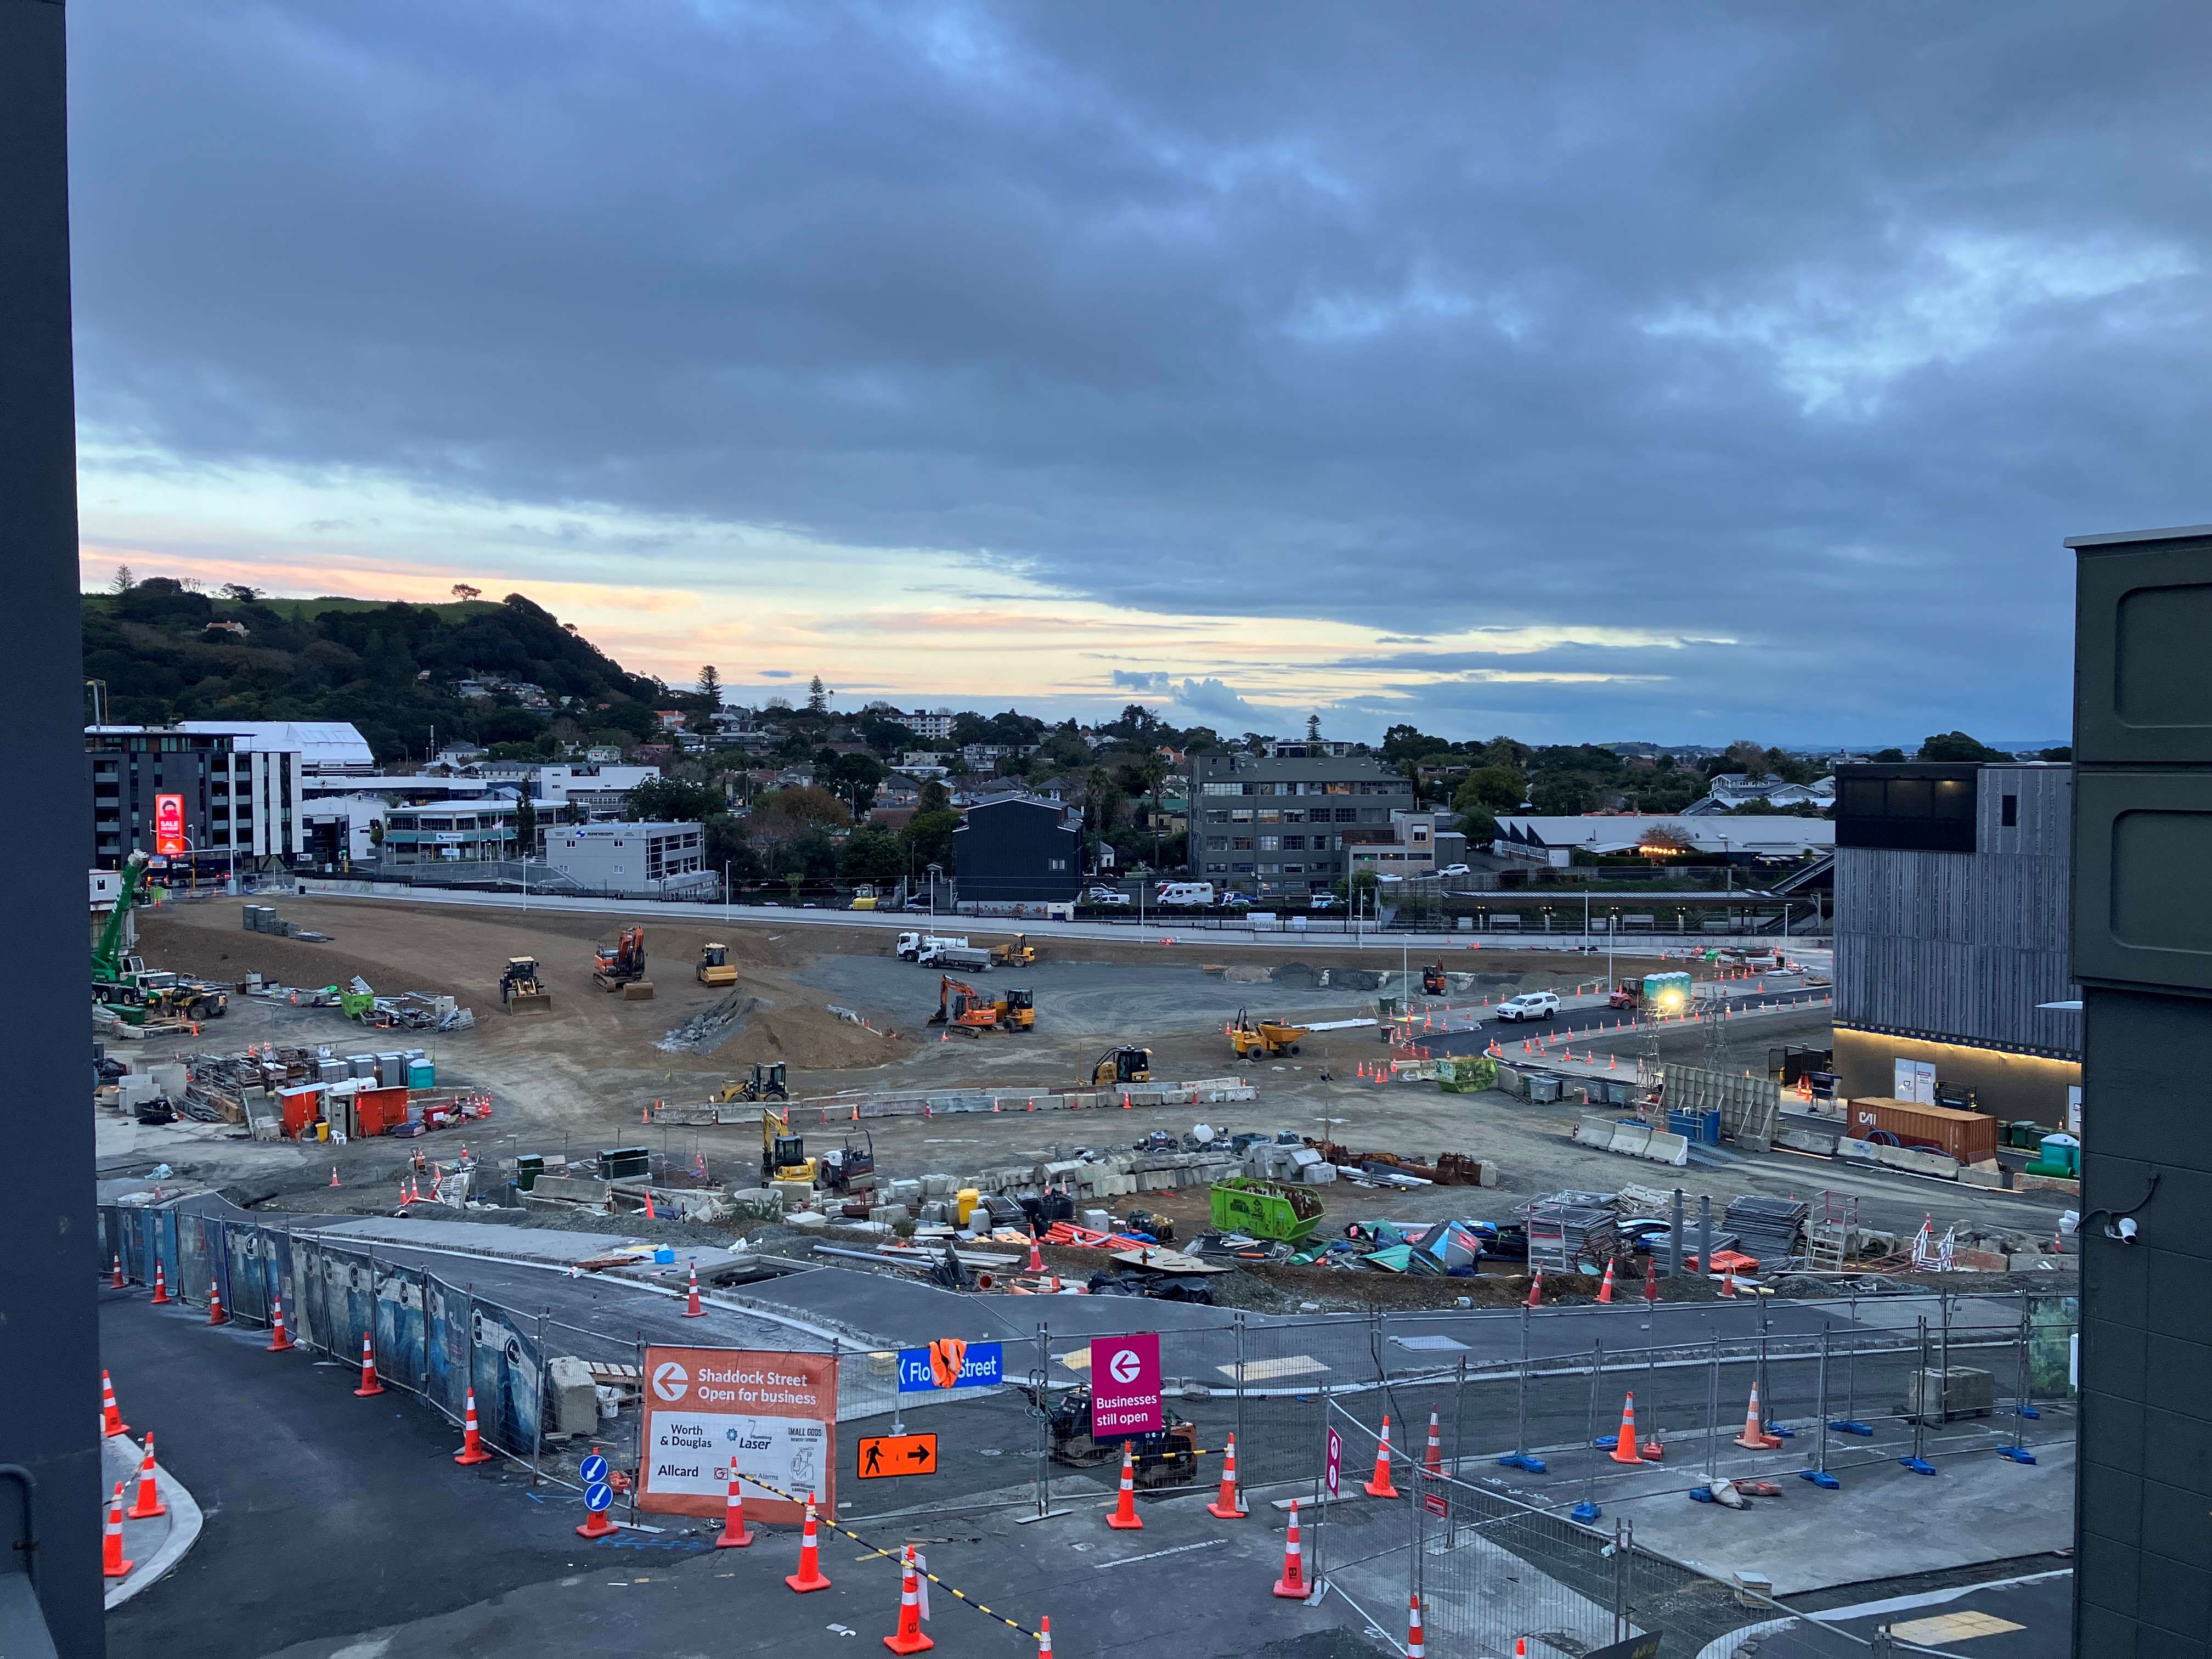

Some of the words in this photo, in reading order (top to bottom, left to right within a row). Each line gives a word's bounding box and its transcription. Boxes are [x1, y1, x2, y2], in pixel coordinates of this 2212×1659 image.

[1859, 1111, 1876, 1125] CAI
[958, 1356, 996, 1379] Street
[698, 1368, 764, 1384] Shaddock
[767, 1372, 808, 1386] Street
[698, 1386, 735, 1402] Open
[738, 1388, 758, 1401] for
[761, 1389, 816, 1405] business
[1097, 1395, 1157, 1409] Businesses
[1097, 1413, 1116, 1426] still
[1120, 1413, 1148, 1425] open
[671, 1424, 702, 1435] Worth
[788, 1427, 806, 1436] SMALL
[807, 1428, 822, 1437] GODS
[660, 1436, 668, 1446] &
[672, 1436, 712, 1449] Douglas
[740, 1437, 771, 1449] Laser
[658, 1465, 698, 1477] Allcard
